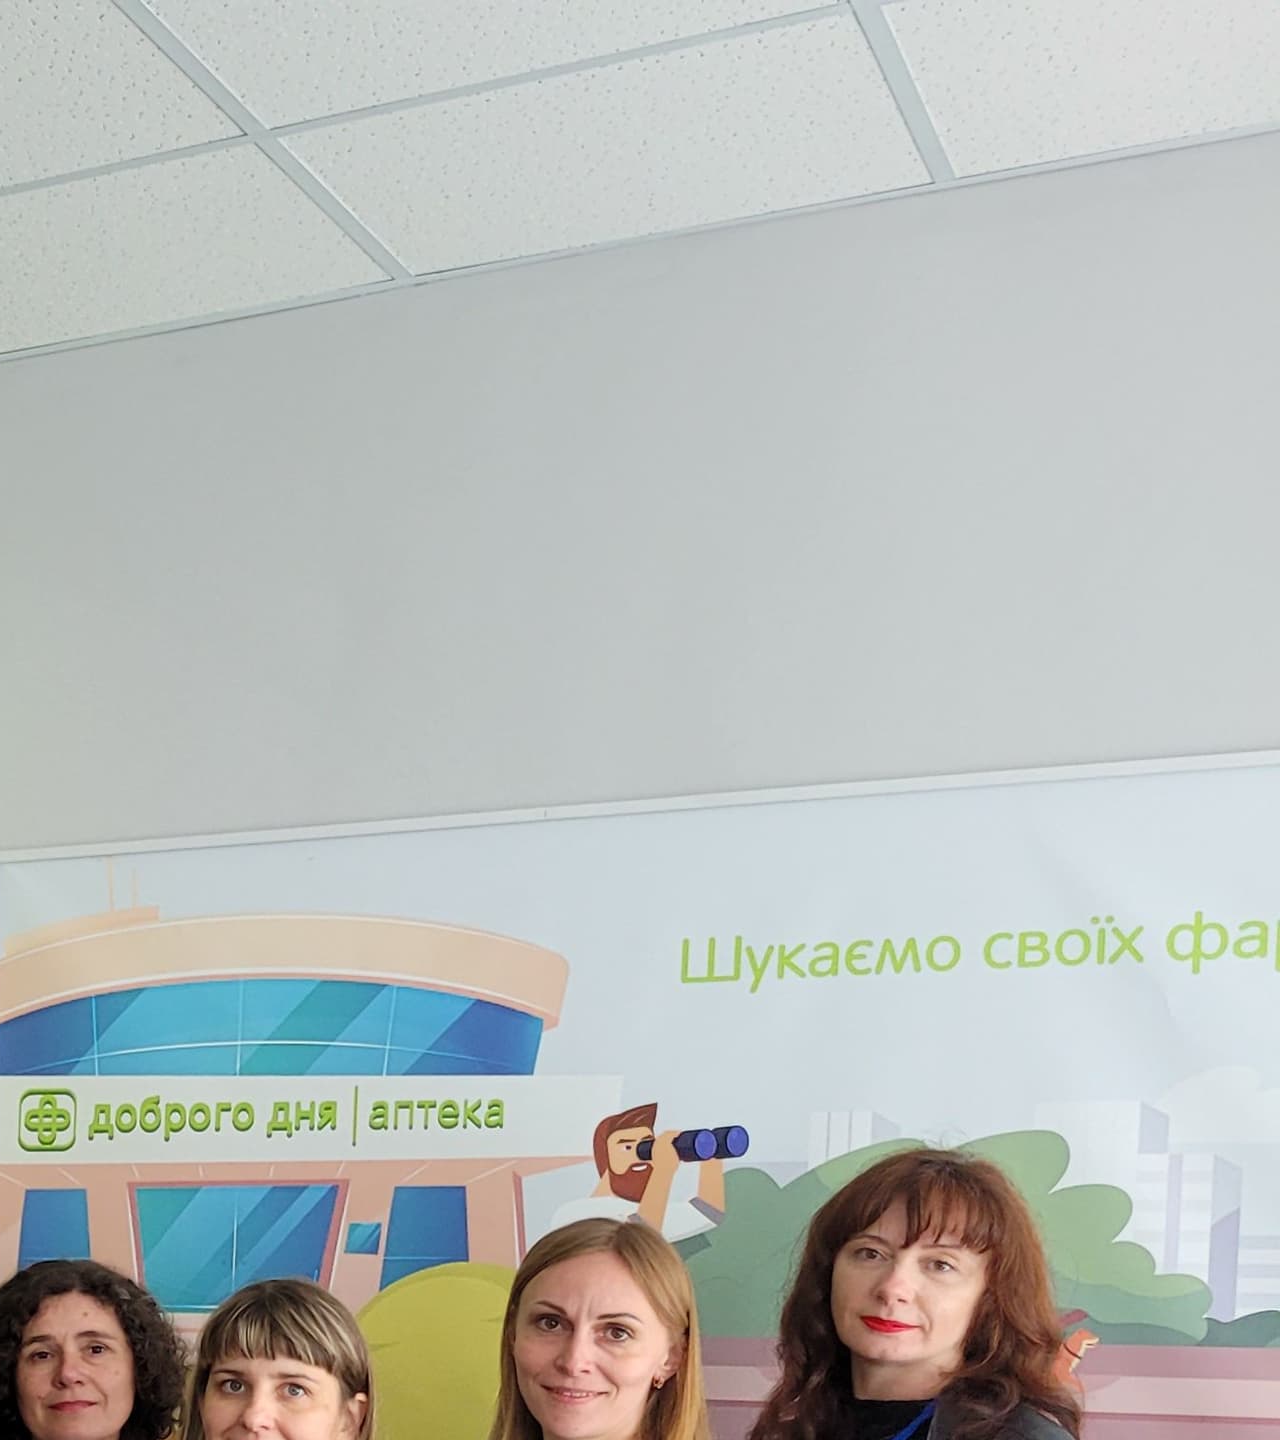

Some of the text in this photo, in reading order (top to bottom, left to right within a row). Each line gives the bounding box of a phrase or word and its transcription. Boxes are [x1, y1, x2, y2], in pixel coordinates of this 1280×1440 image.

[680, 910, 1280, 994] Шукаємо своїх фа
[87, 1094, 507, 1142] доброго дня аптека
